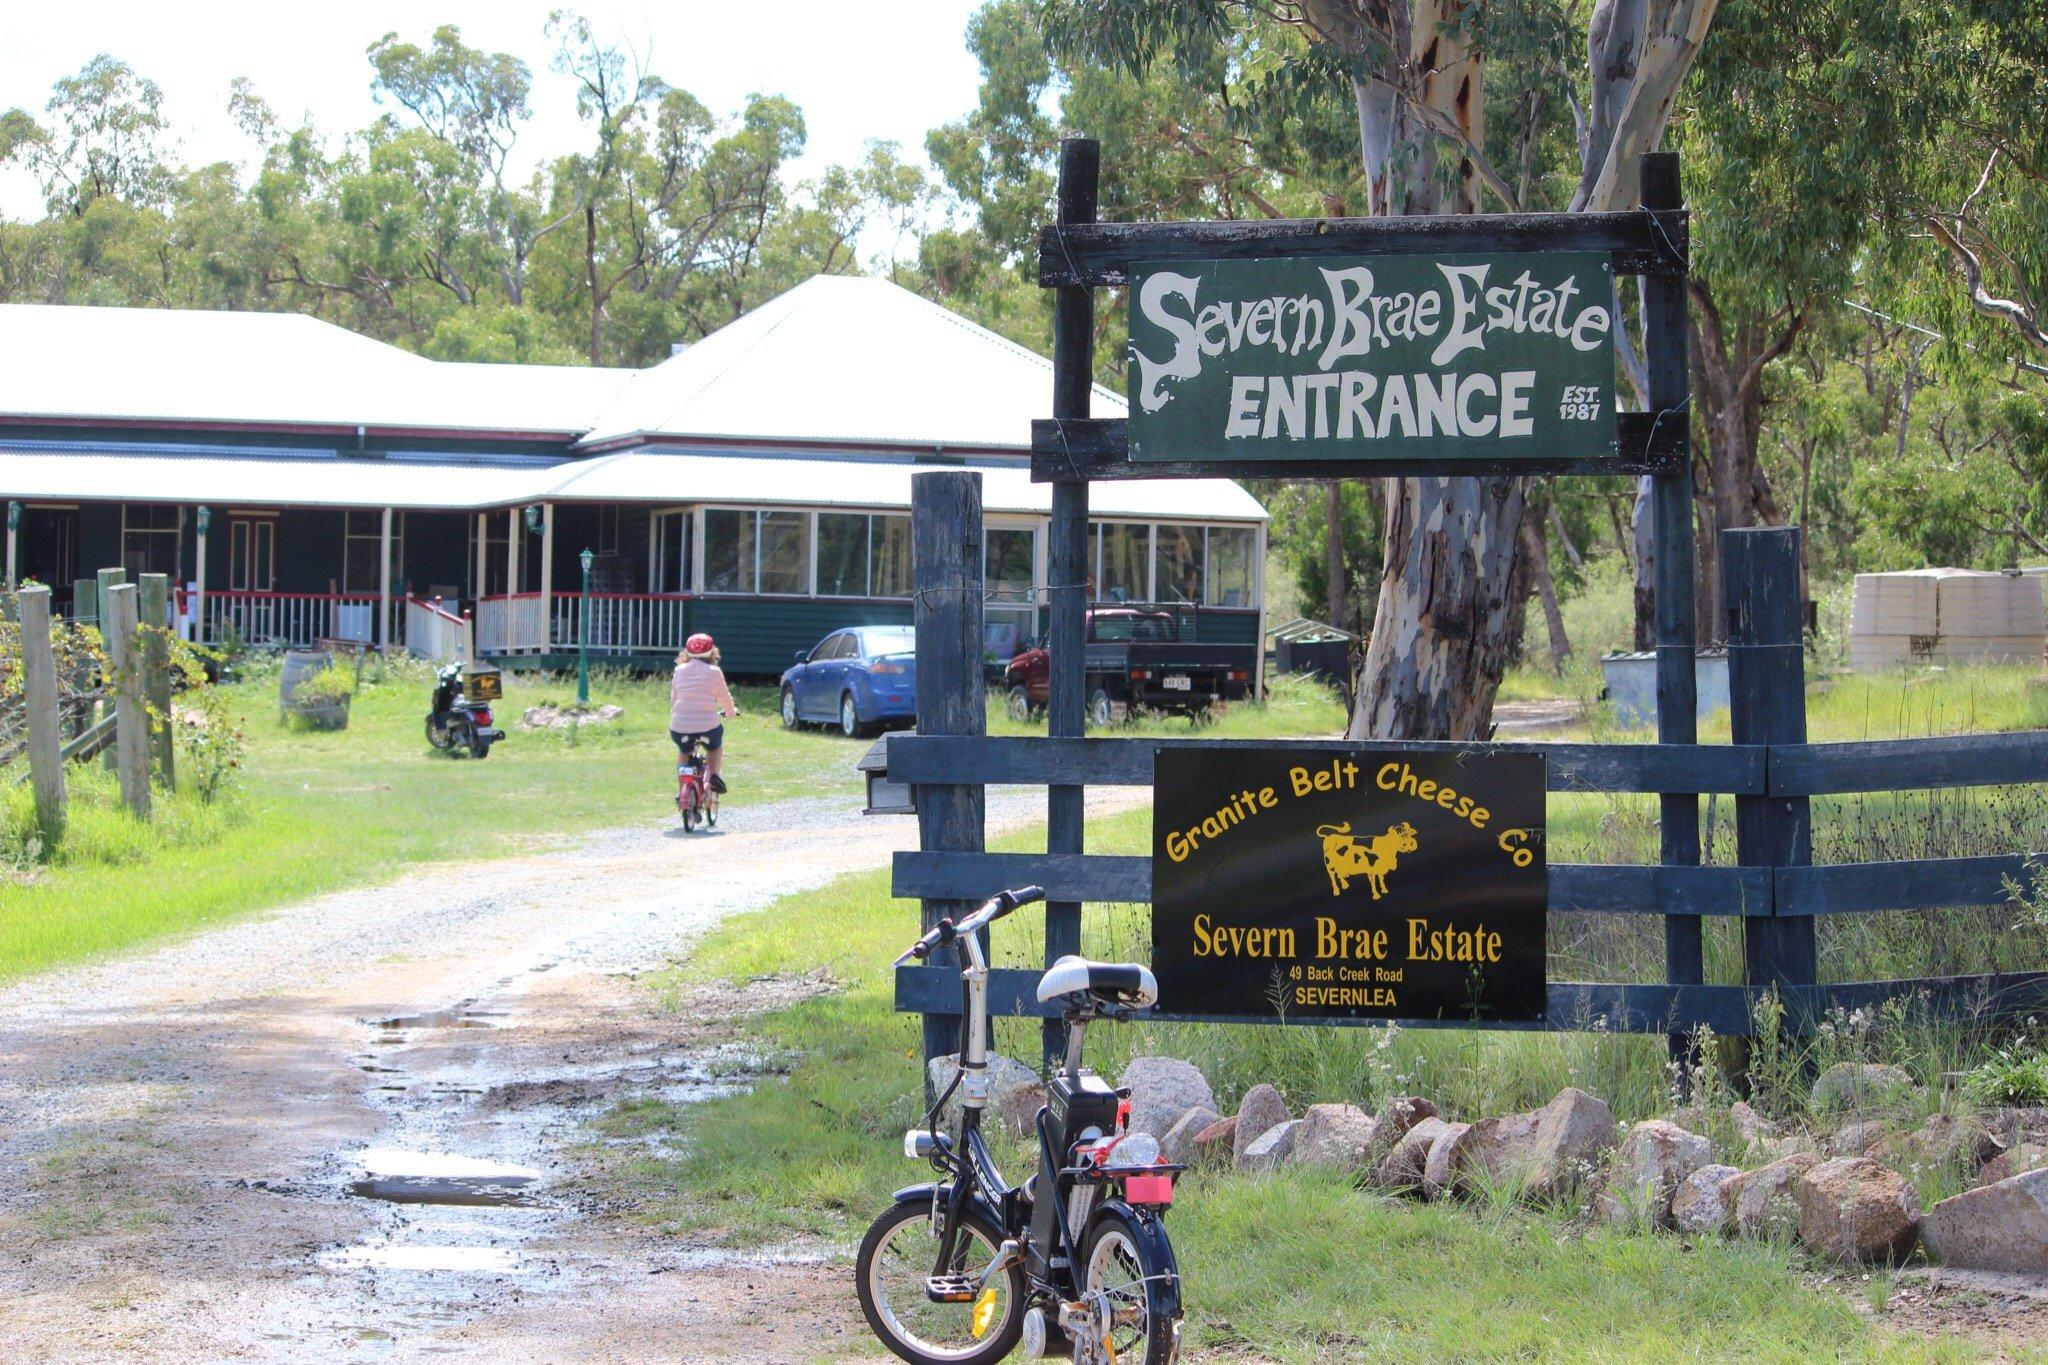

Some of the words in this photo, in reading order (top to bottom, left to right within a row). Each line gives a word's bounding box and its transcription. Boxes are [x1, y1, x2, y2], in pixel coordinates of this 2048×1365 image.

[1135, 271, 1324, 413] Severn
[1317, 266, 1441, 371] Brae
[1431, 263, 1610, 366] Estate
[1225, 370, 1537, 441] ENTRANCE
[1561, 385, 1600, 403] EST.
[1559, 403, 1601, 421] 1987
[1165, 786, 1279, 863] Granite
[1289, 759, 1360, 798] Belt
[1376, 763, 1490, 829] Cheese
[1499, 828, 1533, 867] Co
[1193, 914, 1296, 958] Severn
[1315, 917, 1388, 960] Brae
[1406, 918, 1502, 963] Estate
[1289, 965, 1302, 980] 49
[1308, 966, 1333, 981] Back
[1339, 966, 1370, 982] Creek
[1375, 967, 1403, 982] Road
[1295, 986, 1397, 1007] SEVERNLEA
